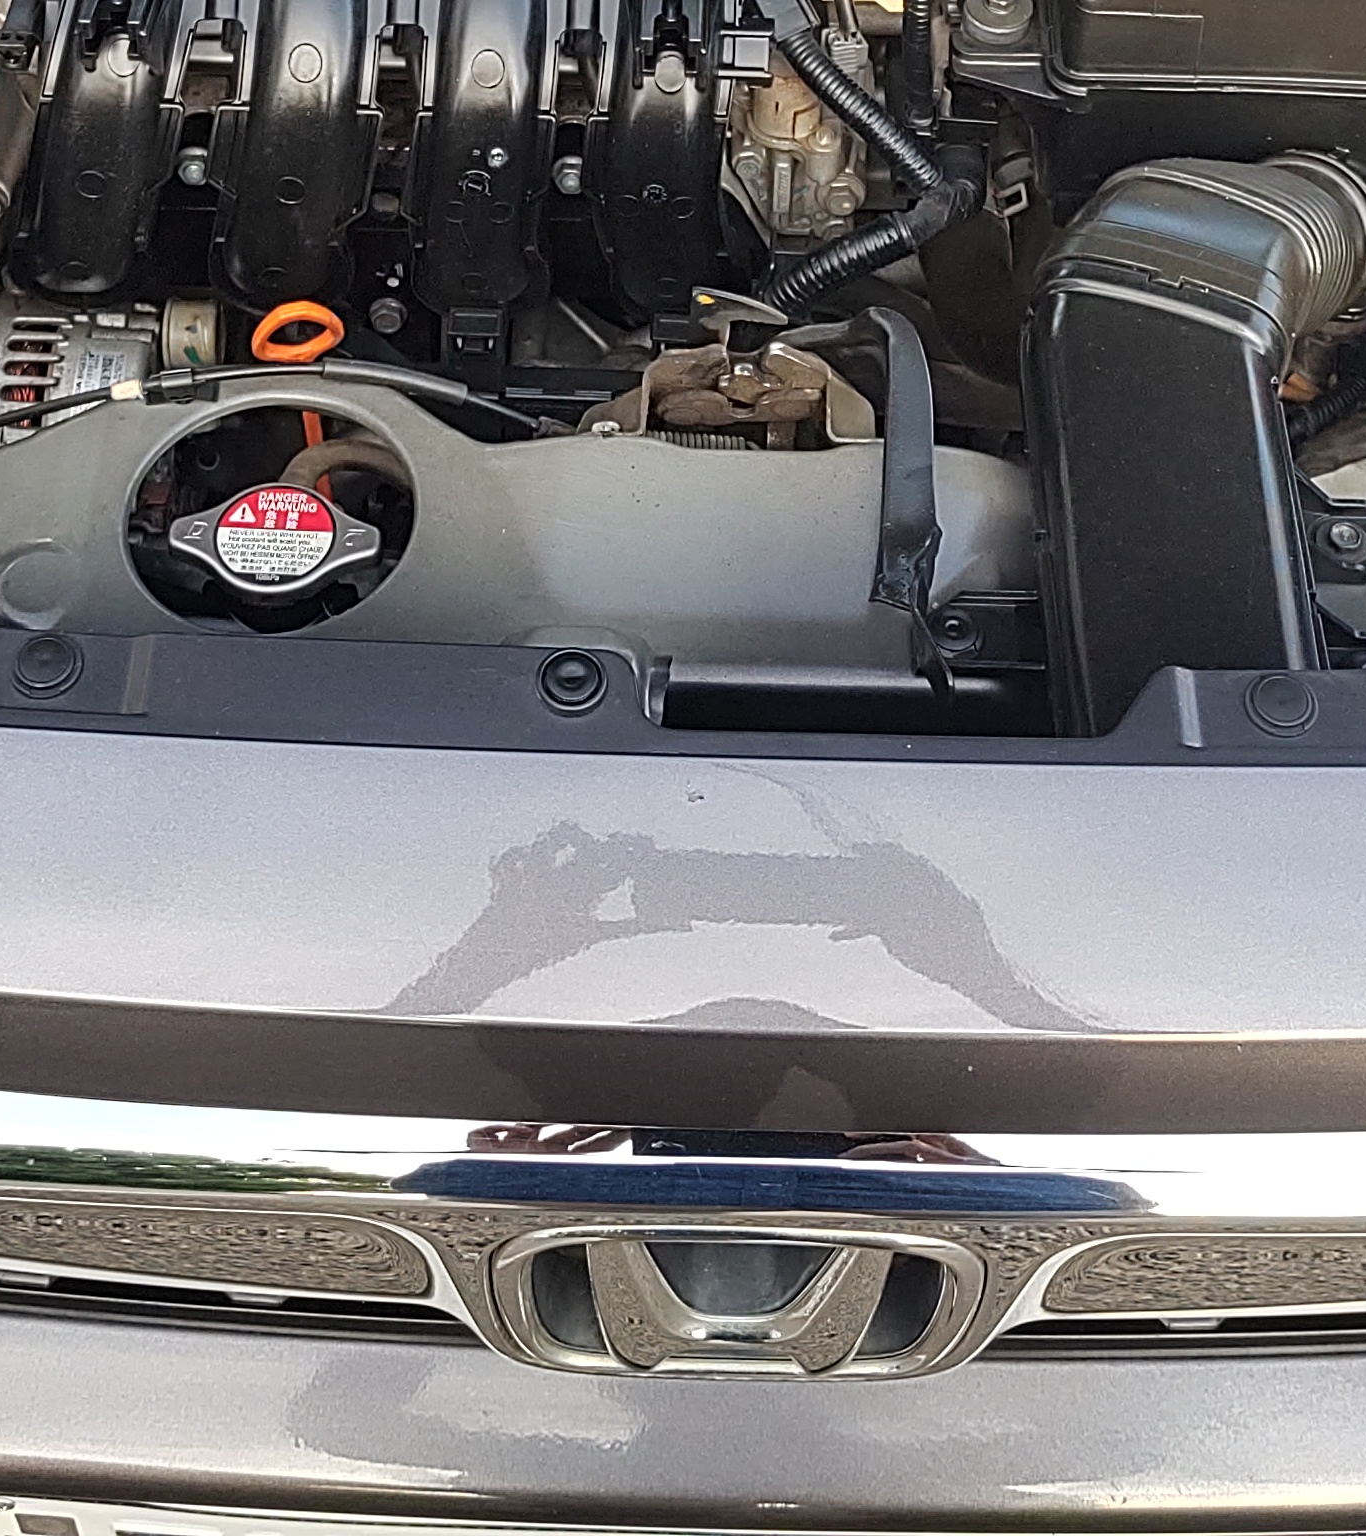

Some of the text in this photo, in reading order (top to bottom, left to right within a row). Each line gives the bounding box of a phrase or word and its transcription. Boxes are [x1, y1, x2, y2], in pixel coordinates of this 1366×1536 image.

[258, 491, 308, 503] DANGER
[258, 501, 317, 512] WARNUNG
[229, 529, 254, 537] NEVER
[256, 529, 277, 537] OPEN
[299, 546, 323, 554] CHAUD
